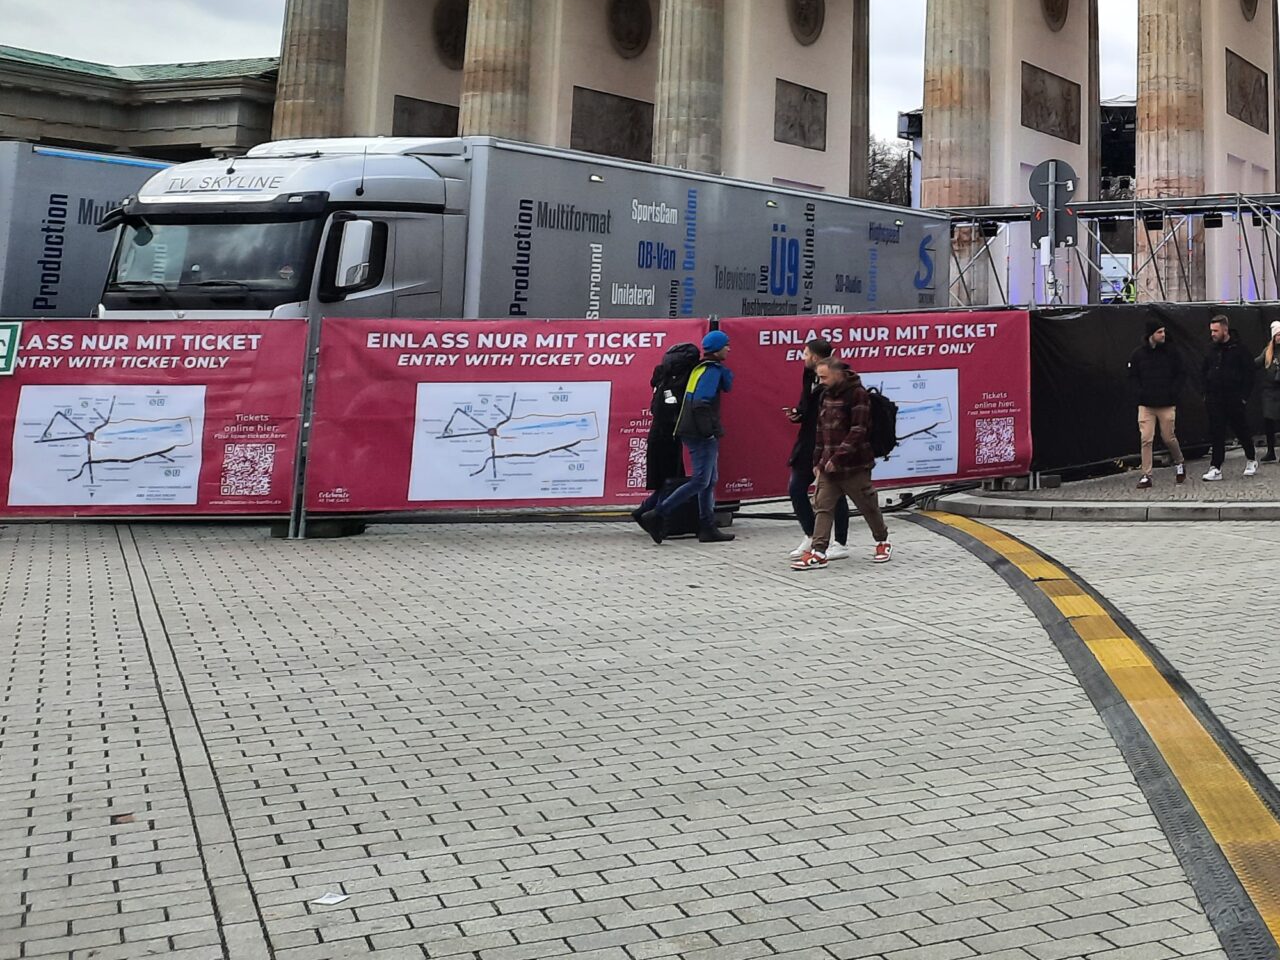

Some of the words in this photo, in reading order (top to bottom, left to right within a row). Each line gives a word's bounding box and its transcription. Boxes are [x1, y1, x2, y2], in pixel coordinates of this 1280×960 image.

[168, 177, 193, 190] TV
[199, 176, 285, 189] SKYLINE
[536, 201, 612, 234] Multiformat
[631, 199, 678, 224] SportsCam
[682, 189, 697, 270] Definition
[32, 193, 68, 309] Production
[509, 199, 533, 315] Production
[637, 240, 676, 271] OB-Van
[770, 223, 800, 297] Ü9
[801, 203, 816, 312] tv-skyline.de
[586, 243, 603, 319] Surround
[715, 265, 756, 290] Television
[757, 265, 769, 294] Live
[611, 283, 655, 306] Unilateral
[681, 276, 697, 314] High
[81, 334, 129, 350] NUR
[136, 334, 176, 350] MIT
[181, 334, 262, 350] TICKET
[366, 333, 470, 348] EINLASS
[477, 333, 528, 348] NUR
[536, 333, 578, 348] MIT
[584, 332, 667, 348] TICKET
[759, 328, 843, 345] EINLASS
[849, 327, 889, 342] NUR
[895, 325, 929, 340] MIT
[934, 323, 998, 339] TICKET
[15, 355, 65, 369] NTRY
[68, 356, 116, 368] WITH
[121, 356, 180, 368] TICKET
[183, 356, 230, 368] ONLY
[397, 354, 459, 367] ENTRY
[464, 354, 513, 366] WITH
[519, 353, 584, 366] TICKET
[587, 353, 635, 366] ONLY
[840, 346, 879, 359] WITH
[884, 344, 935, 357] TICKET
[938, 342, 975, 355] ONLY
[974, 401, 997, 409] online
[224, 424, 255, 432] online
[235, 414, 269, 422] Tickets
